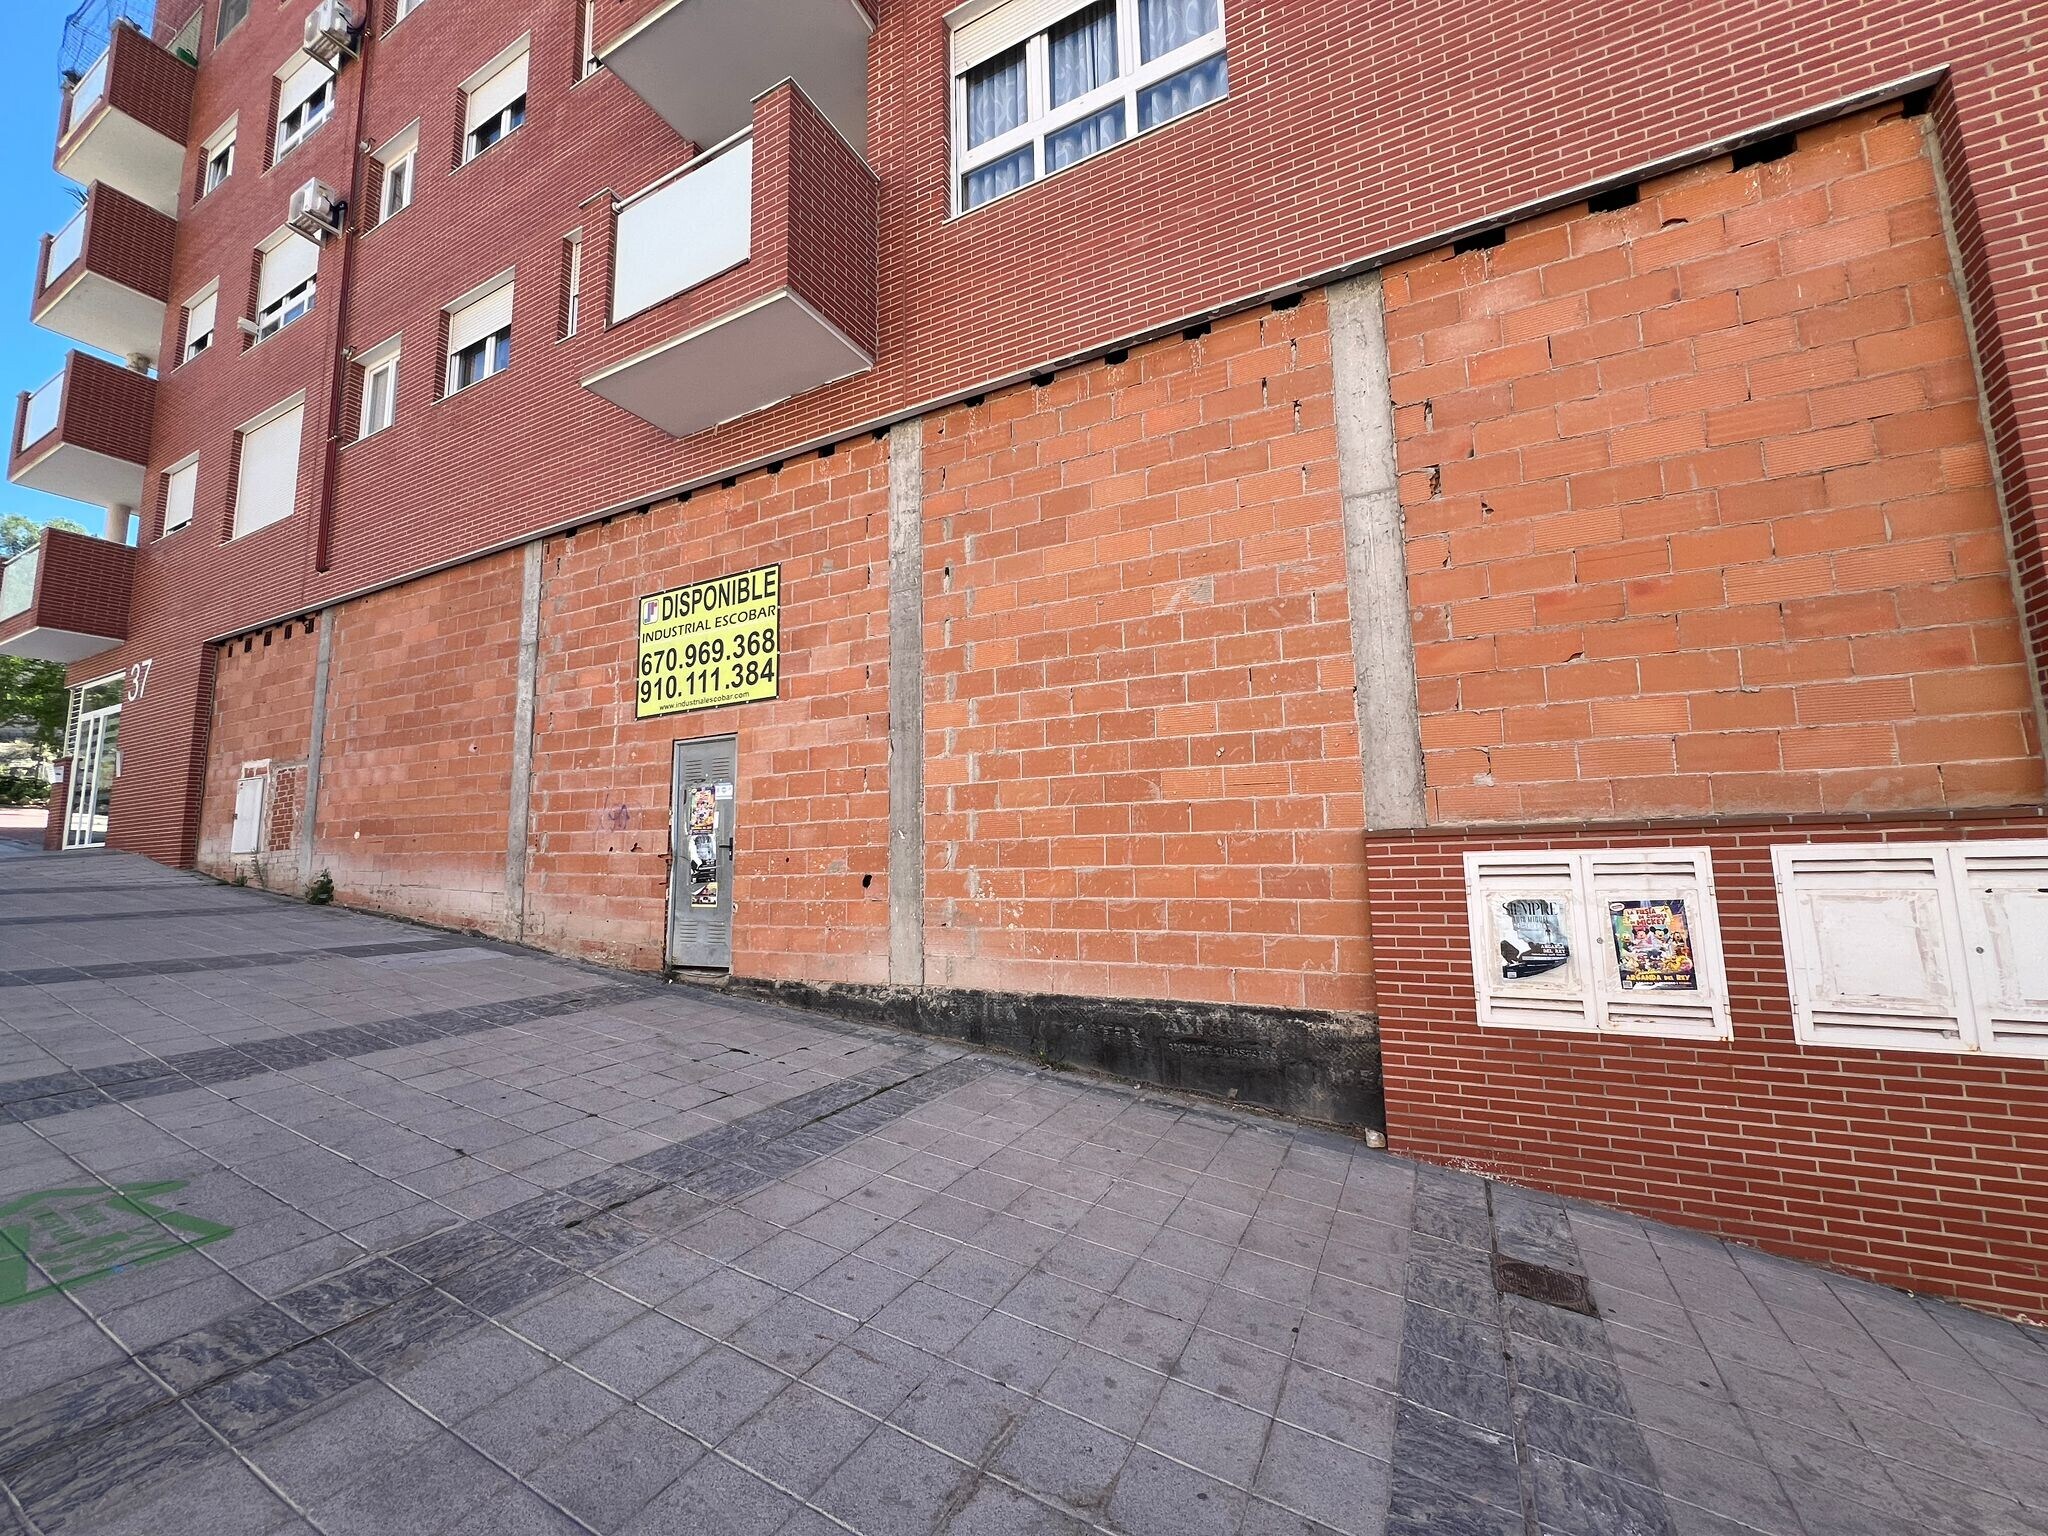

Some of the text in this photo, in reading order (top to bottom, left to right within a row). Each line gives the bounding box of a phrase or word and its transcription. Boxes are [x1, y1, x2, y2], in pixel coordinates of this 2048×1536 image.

[662, 570, 776, 621] DISPONIBLE
[642, 604, 776, 643] INDUSTRIAL ESCOBAR
[641, 628, 775, 676] 670.969.368
[128, 658, 153, 702] 37
[640, 658, 775, 703] 910.111.384
[659, 691, 750, 711] www.industrialescobar.com
[1502, 902, 1559, 916] SIEMPRE
